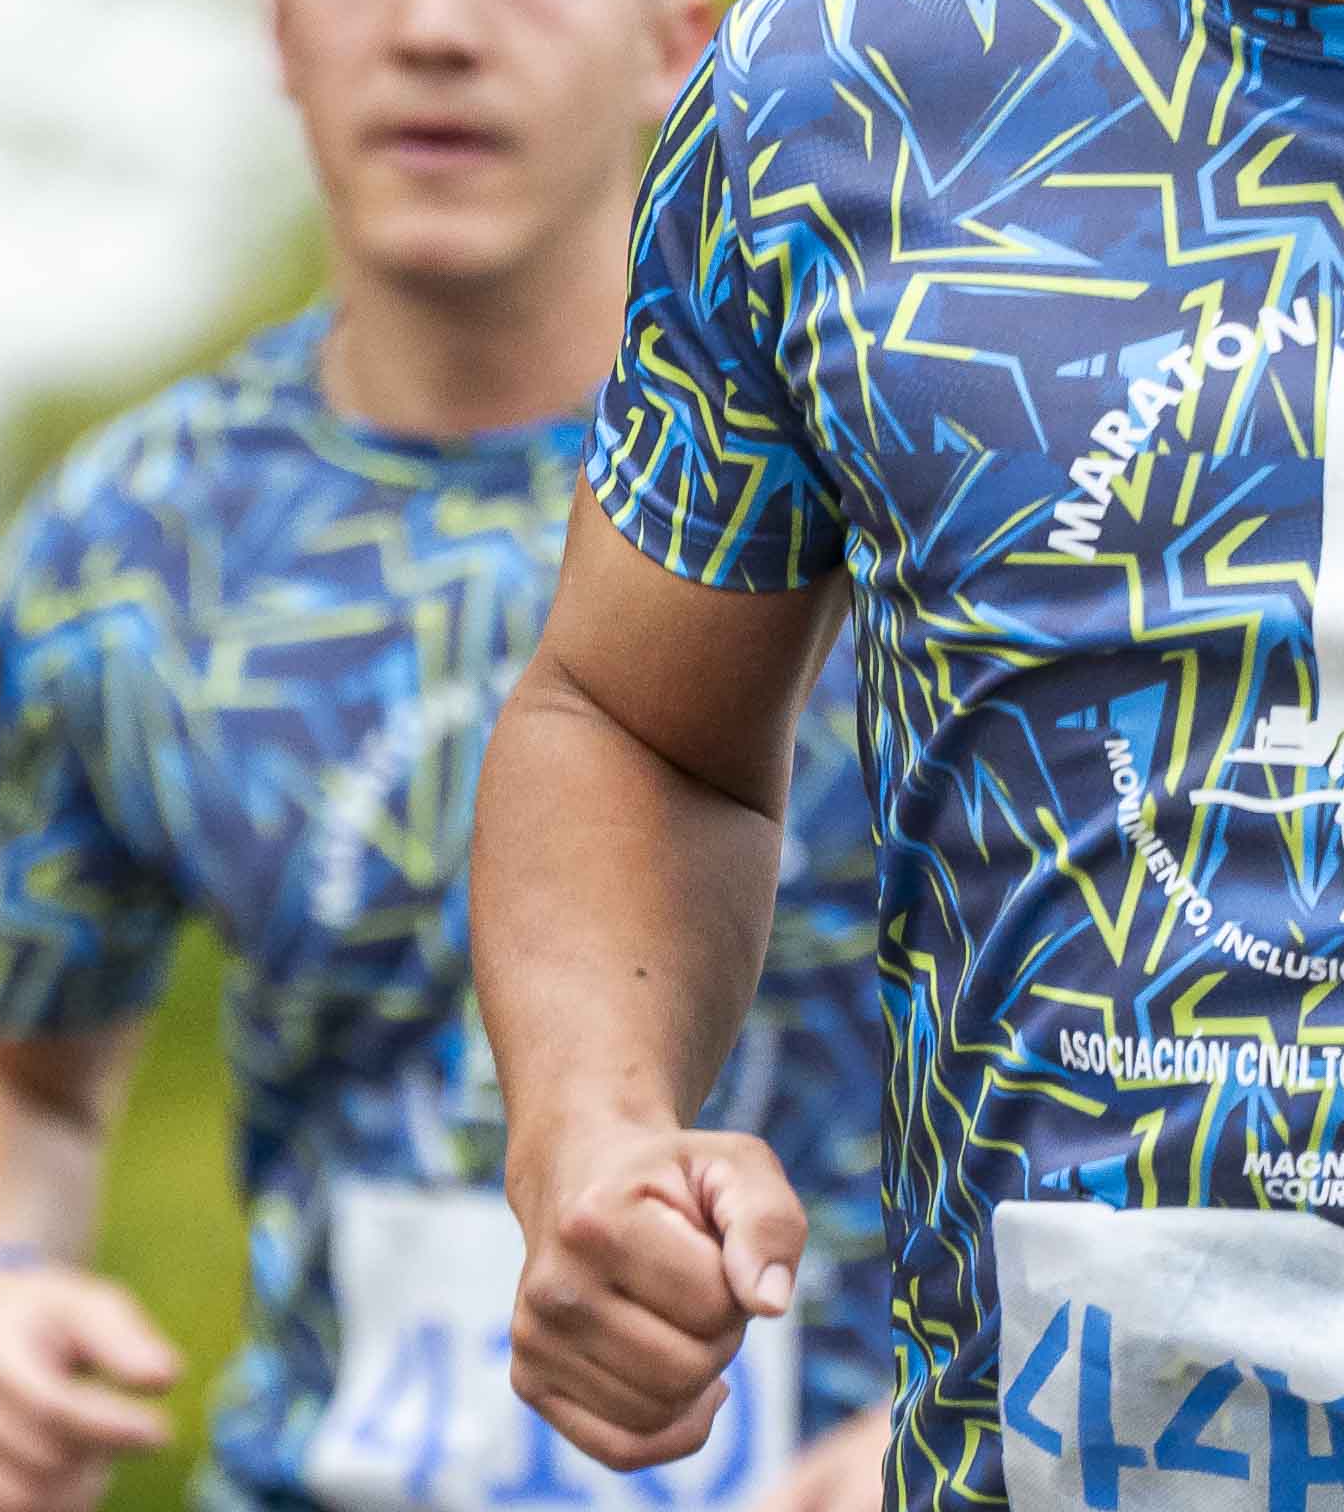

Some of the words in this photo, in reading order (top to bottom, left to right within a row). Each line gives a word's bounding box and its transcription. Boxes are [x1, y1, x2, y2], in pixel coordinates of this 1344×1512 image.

[1047, 296, 1317, 562] MARATÓN
[1104, 738, 1213, 937] MOVIMIENTO,
[1058, 1026, 1229, 1086] ASOCIACIÓN
[1235, 1041, 1317, 1090] CIVIL
